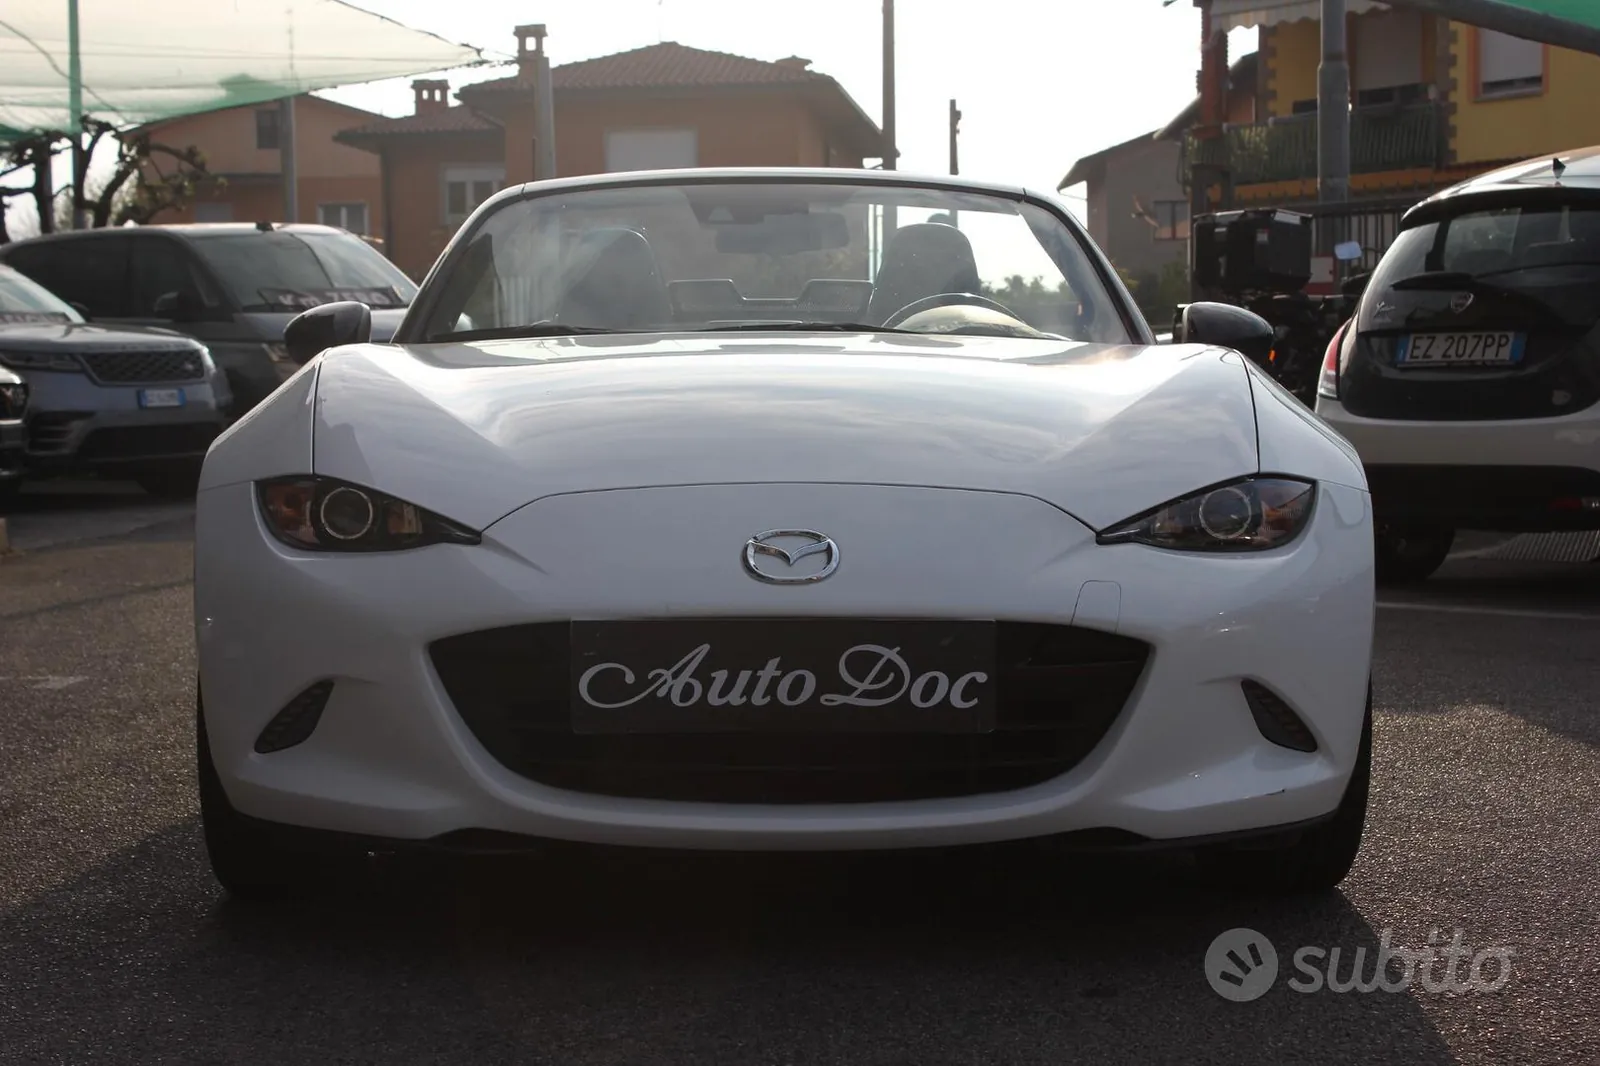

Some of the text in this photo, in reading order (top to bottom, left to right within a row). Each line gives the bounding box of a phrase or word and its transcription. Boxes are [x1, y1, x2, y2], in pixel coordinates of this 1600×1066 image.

[1409, 334, 1510, 360] EZ 207PP
[578, 643, 988, 709] Auto Doc
